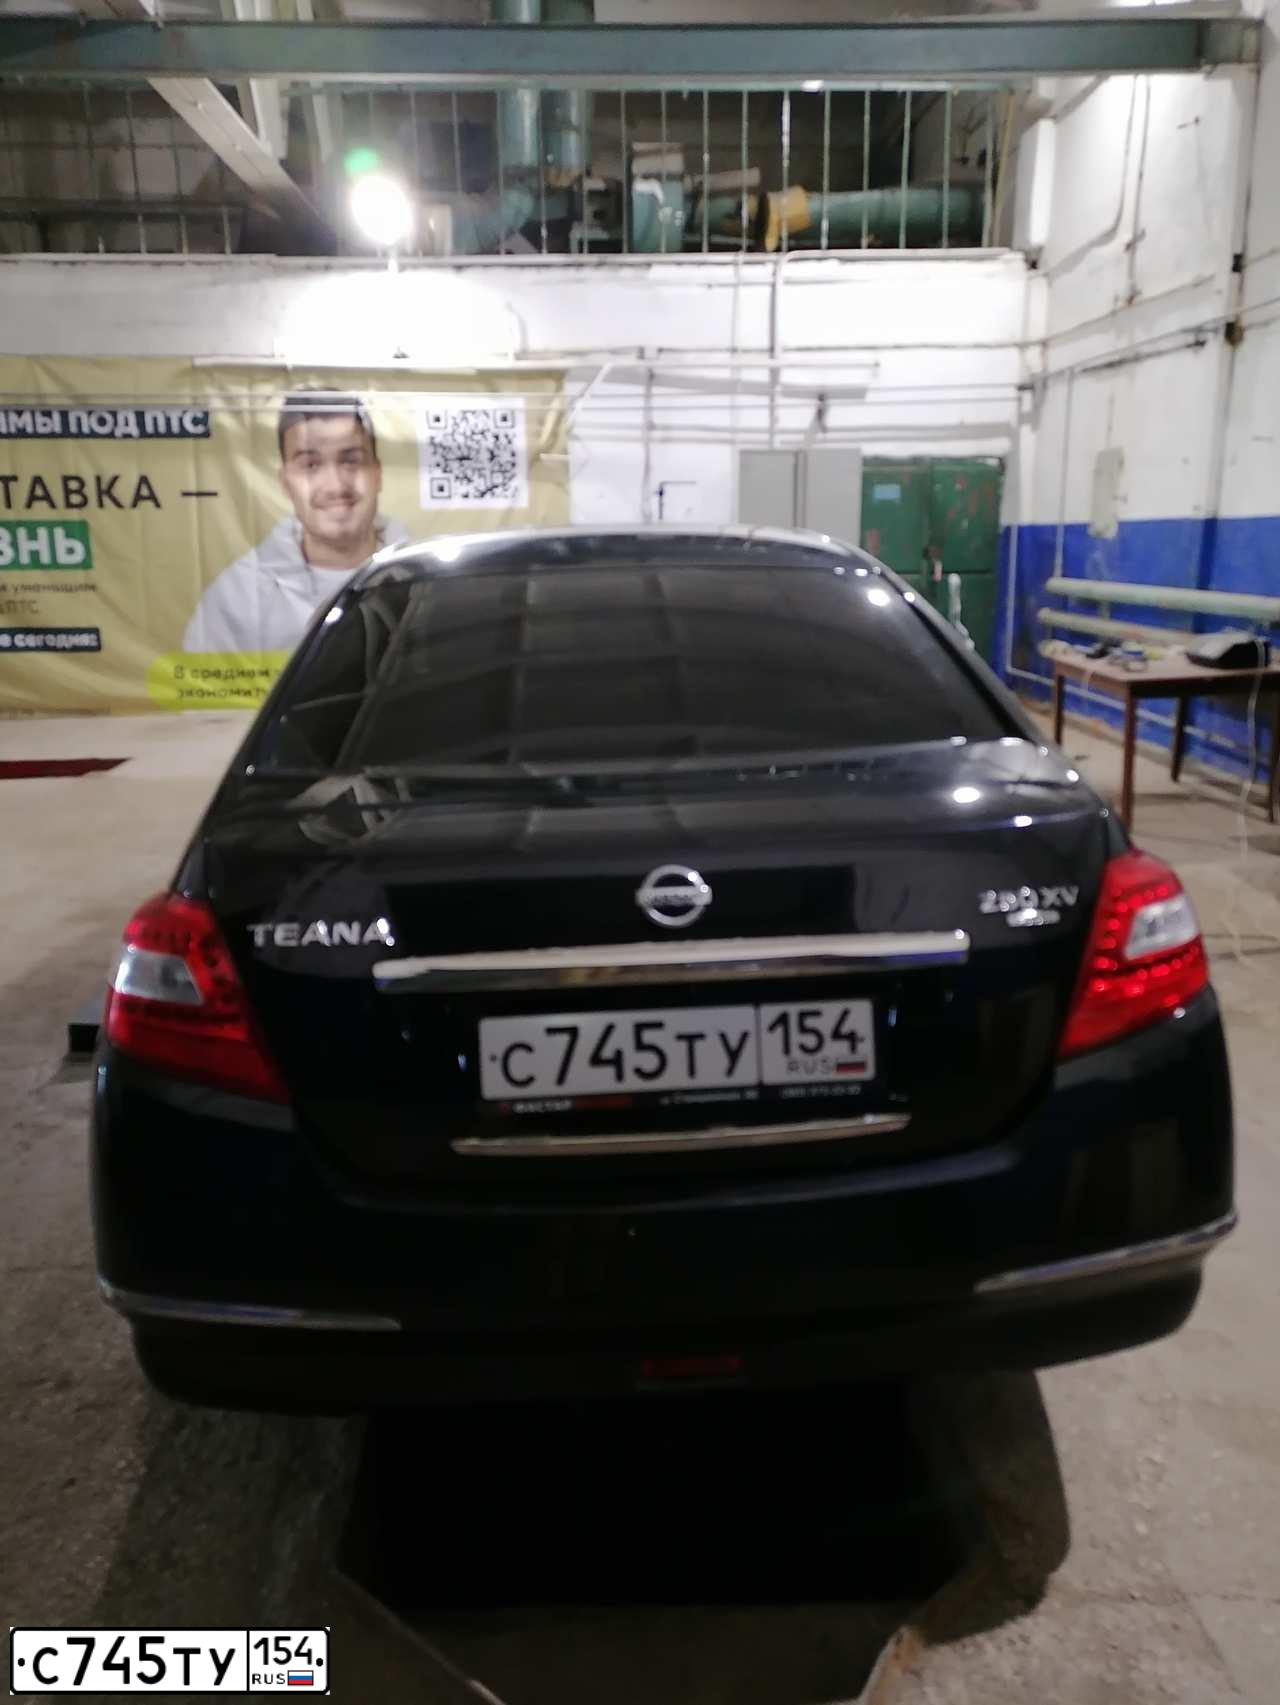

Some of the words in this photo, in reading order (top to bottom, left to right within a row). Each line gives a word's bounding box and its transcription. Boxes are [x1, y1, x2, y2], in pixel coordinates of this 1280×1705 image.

[68, 409, 140, 437] ПОД
[144, 409, 208, 435] ПТС
[246, 918, 395, 947] TEANA
[767, 1007, 861, 1057] 154
